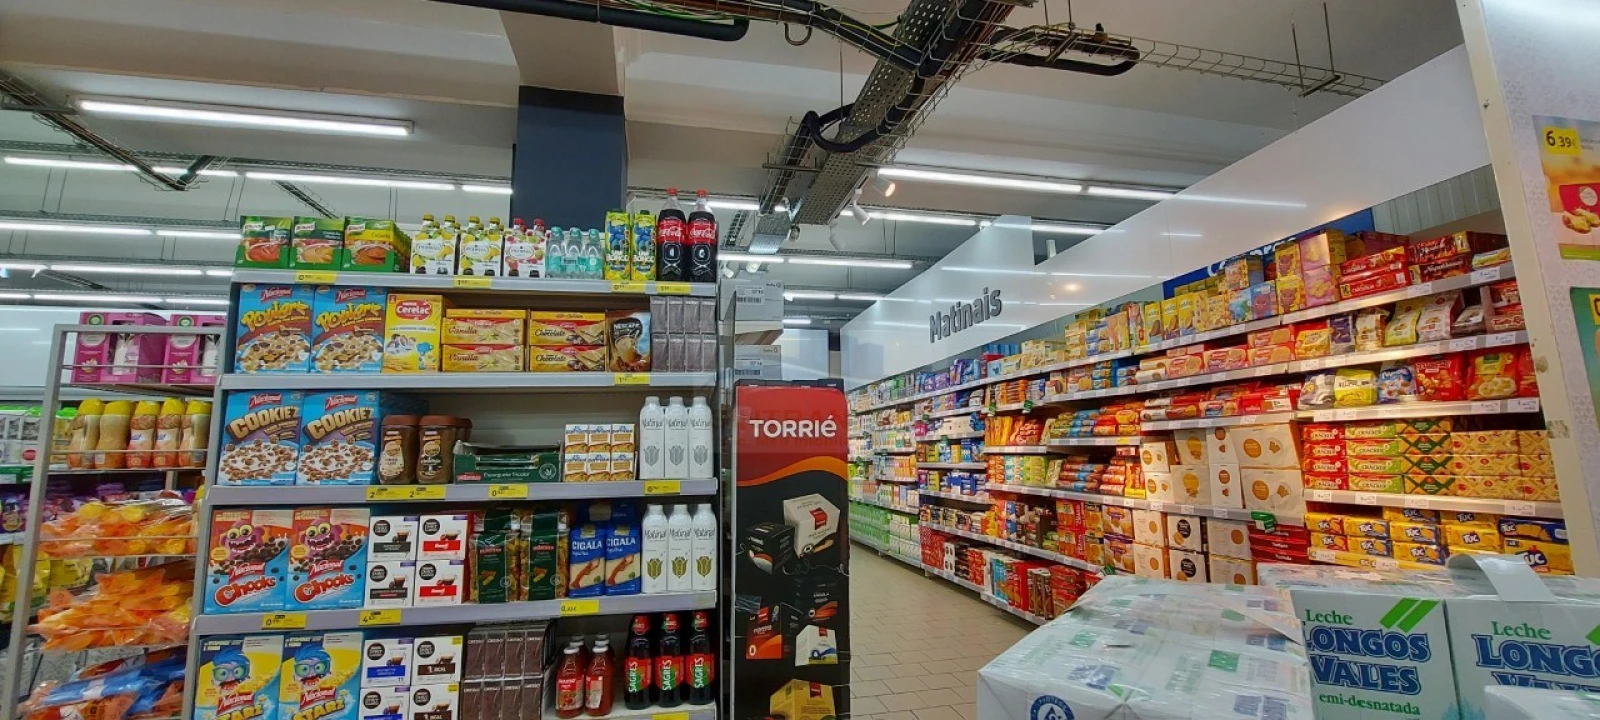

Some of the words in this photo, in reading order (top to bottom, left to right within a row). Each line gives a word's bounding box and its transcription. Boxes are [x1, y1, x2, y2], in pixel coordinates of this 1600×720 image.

[396, 305, 430, 315] Cerelac
[930, 287, 1002, 343] Matinais
[1458, 513, 1473, 522] TUC
[1406, 529, 1420, 537] TUC
[1501, 524, 1516, 532] TUC
[572, 540, 602, 550] CIGALA
[607, 537, 636, 547] CIGALA
[1323, 537, 1333, 545] TUC
[1463, 533, 1479, 542] TUC
[1362, 542, 1374, 550] TUC
[1411, 548, 1425, 556] TUC
[1523, 552, 1546, 566] UC
[214, 574, 276, 607] Chooks
[294, 573, 355, 604] Chooks
[1306, 609, 1353, 625] Leche
[1491, 620, 1551, 640] Leche
[1305, 625, 1431, 663] ONGOS
[629, 661, 637, 692] SAGRES
[662, 659, 671, 690] SAGRES
[695, 656, 704, 688] SAGRES
[1309, 654, 1422, 696] VALES
[1319, 693, 1420, 715] emi-desnatada
